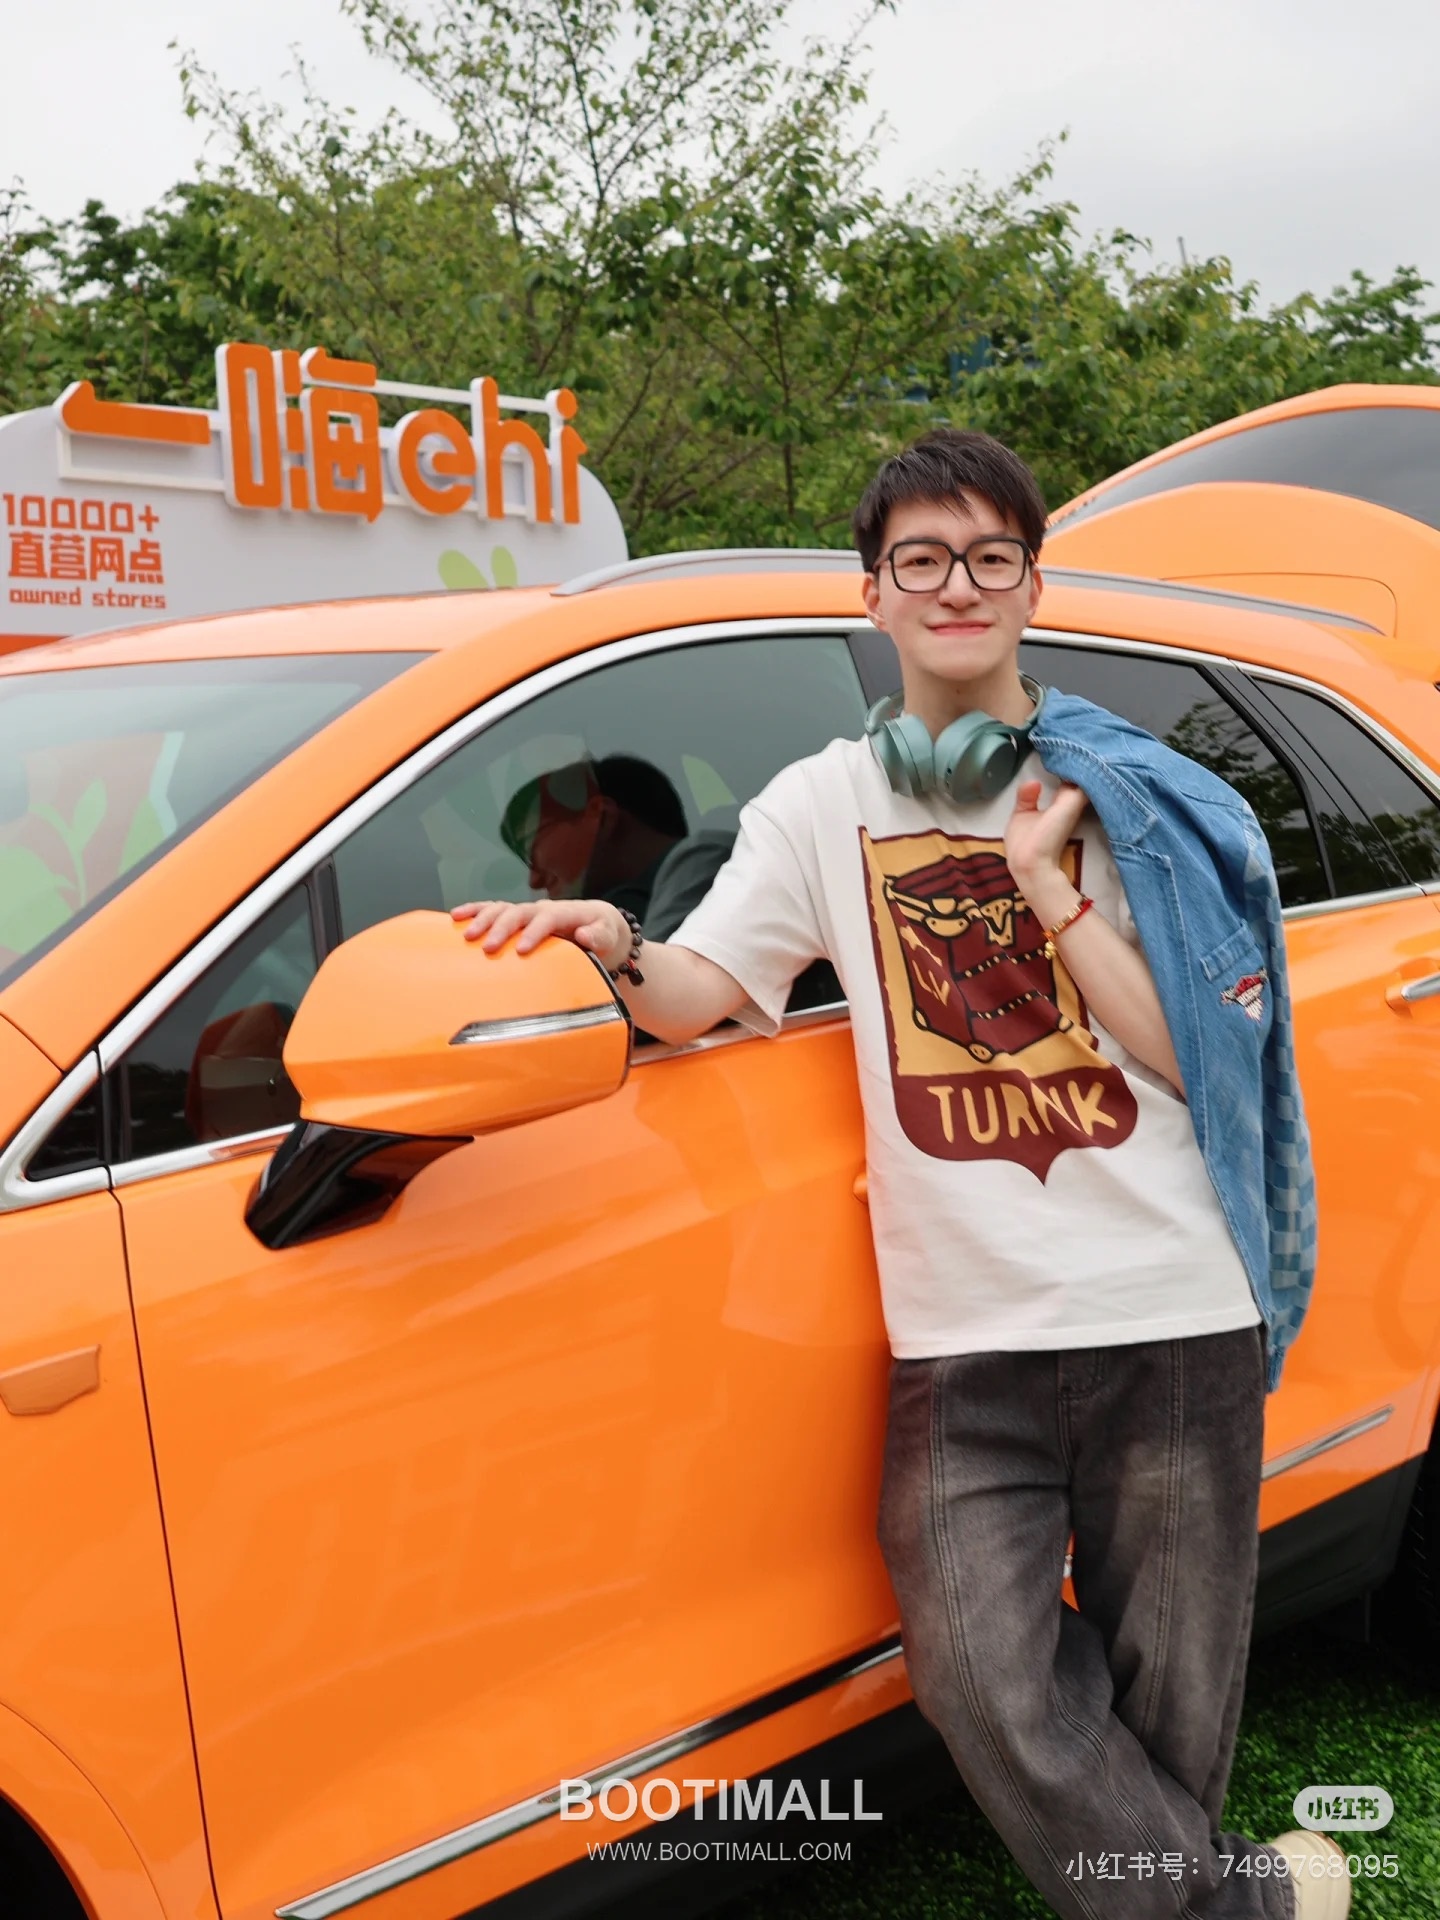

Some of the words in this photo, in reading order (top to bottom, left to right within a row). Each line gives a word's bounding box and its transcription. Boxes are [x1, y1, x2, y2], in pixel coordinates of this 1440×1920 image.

[59, 340, 384, 524] 一嗨
[397, 374, 588, 524] ehi
[2, 493, 160, 534] 10000+
[8, 531, 165, 585] 直营网点
[9, 586, 82, 606] owned
[92, 587, 167, 610] stores
